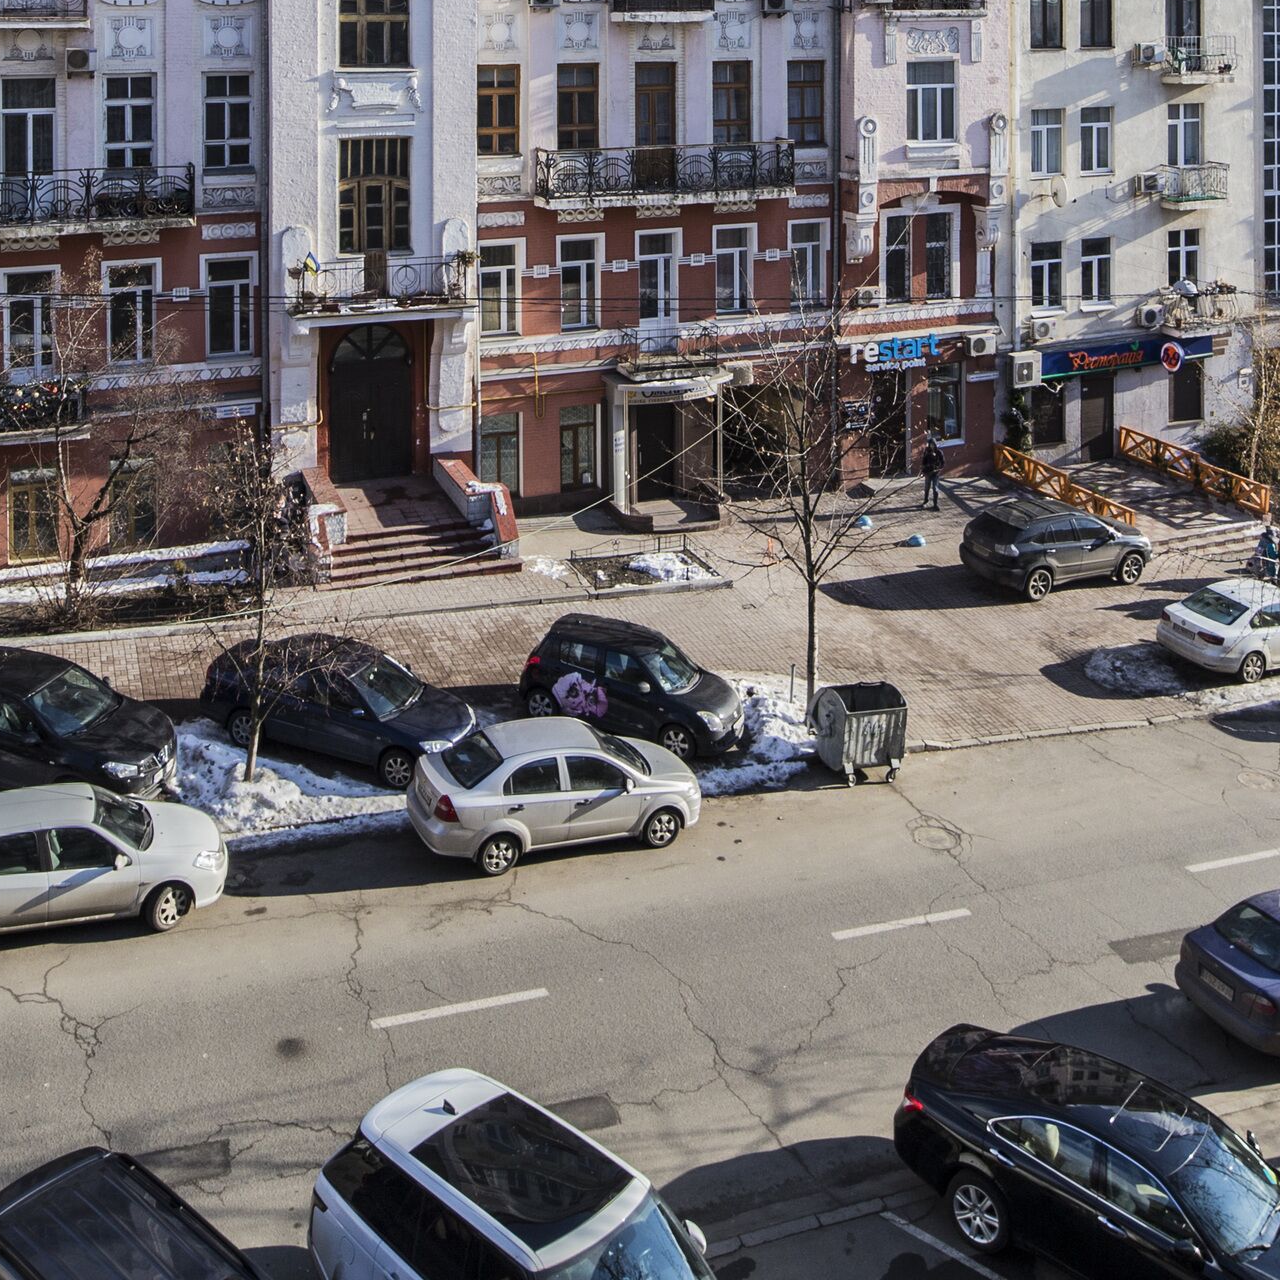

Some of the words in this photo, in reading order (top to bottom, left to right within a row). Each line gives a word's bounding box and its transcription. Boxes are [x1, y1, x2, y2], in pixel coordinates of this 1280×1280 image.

[850, 332, 939, 364] restart
[865, 361, 900, 372] service
[901, 358, 926, 369] point
